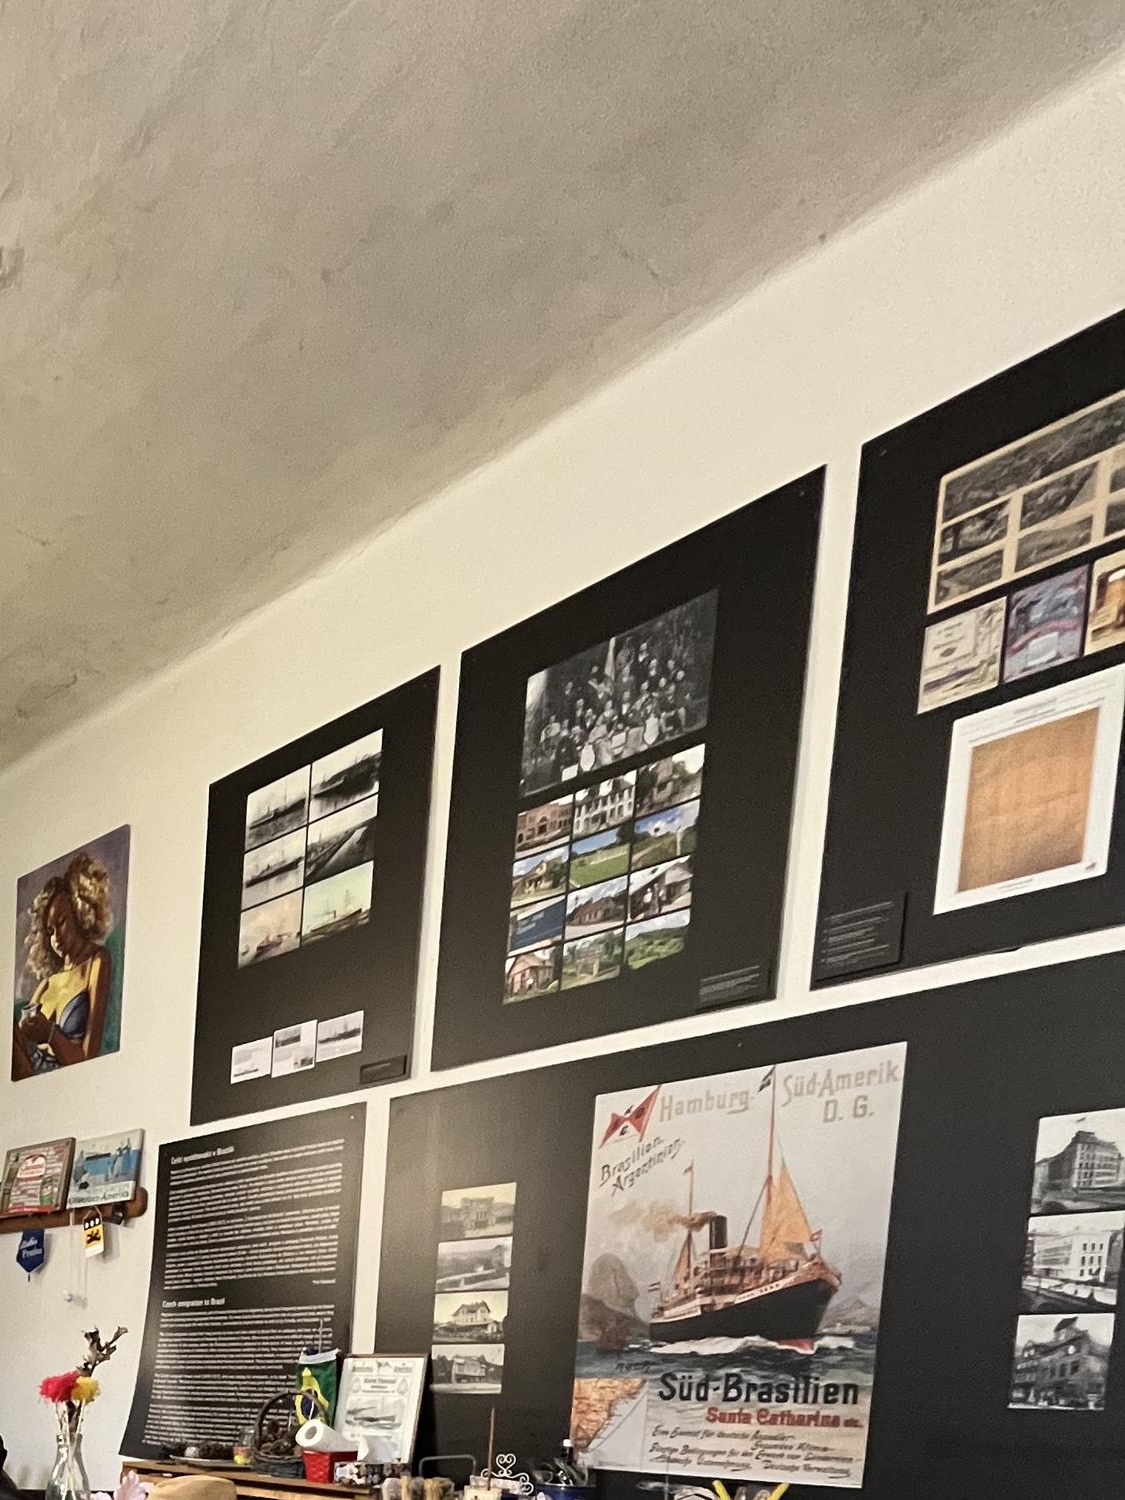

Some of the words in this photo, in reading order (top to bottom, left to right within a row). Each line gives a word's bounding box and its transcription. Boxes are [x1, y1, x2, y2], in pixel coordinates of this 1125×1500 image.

[853, 1094, 875, 1119] G.
[658, 1372, 860, 1405] Süd-Brasilien
[706, 1406, 752, 1425] Santa
[756, 1408, 841, 1428] Catharina
